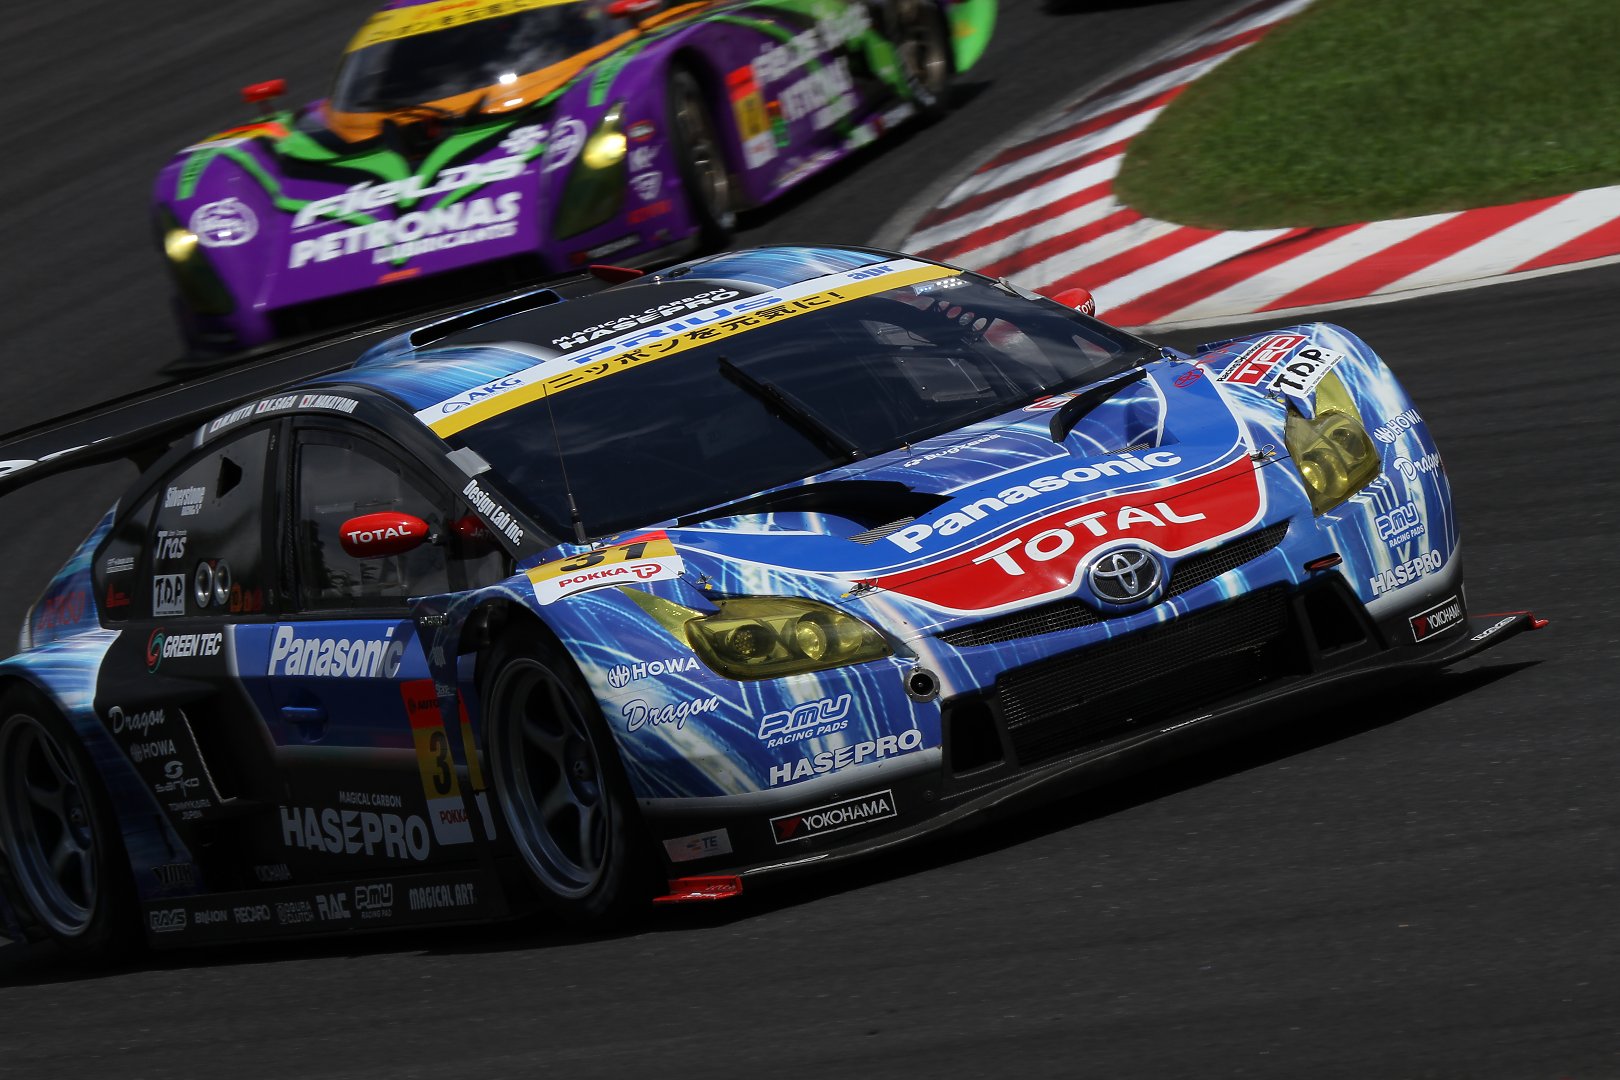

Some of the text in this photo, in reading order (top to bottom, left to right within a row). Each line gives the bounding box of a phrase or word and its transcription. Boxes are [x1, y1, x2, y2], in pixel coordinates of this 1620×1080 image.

[288, 192, 522, 269] PETRONAS
[552, 288, 727, 345] MAGICAL CARBON
[558, 290, 740, 350] HASEPRO
[1074, 298, 1095, 315] TOTA
[567, 295, 783, 365] PRIUS
[1235, 336, 1296, 381] TRD
[468, 377, 522, 401] AKG
[1386, 409, 1423, 438] HOWA
[462, 478, 496, 517] Design
[490, 505, 510, 531] Lab
[886, 451, 1182, 554] Panasonic
[156, 530, 187, 560] Tras
[347, 525, 411, 544] TOTAL
[972, 502, 1206, 576] TOTAL
[1389, 523, 1424, 548] RACING PADS
[560, 542, 649, 571] 31
[558, 567, 628, 588] POKKA
[1370, 549, 1442, 596] HASEPRO
[163, 632, 222, 658] GREEN TEC
[268, 626, 403, 678] Panasonic
[632, 657, 700, 680] HOWA
[108, 705, 166, 737] Dragon
[622, 698, 719, 732] Dragon
[142, 739, 176, 759] HOWA
[767, 720, 848, 748] RACING PADS
[769, 729, 922, 786] HASEPRO
[339, 791, 402, 808] MAGICAL CARBON
[802, 799, 890, 830] YOKOHAMA
[279, 805, 431, 861] HASEPRO
[409, 885, 455, 911] MAGICAL
